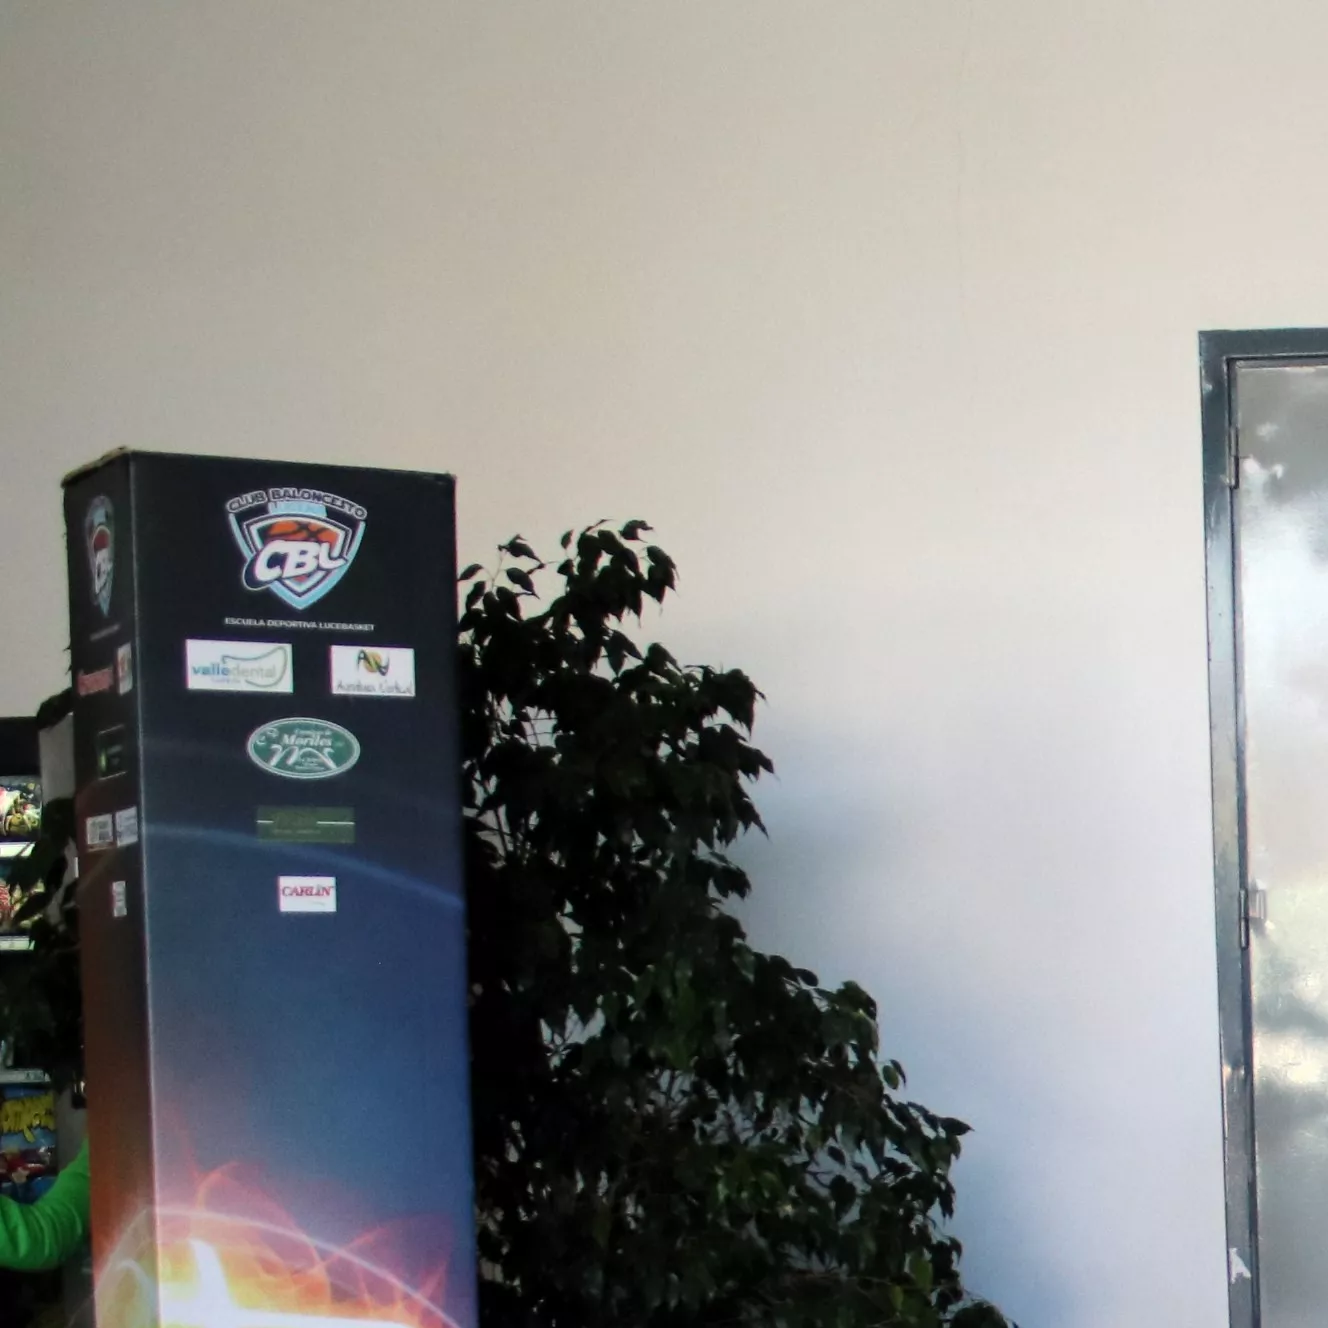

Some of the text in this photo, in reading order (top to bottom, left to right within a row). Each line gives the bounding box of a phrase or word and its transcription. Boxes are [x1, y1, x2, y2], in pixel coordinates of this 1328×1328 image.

[254, 539, 347, 581] CBL
[225, 617, 266, 627] ESCUELA
[267, 619, 318, 629] DEPORTIVA
[192, 662, 277, 678] valledental
